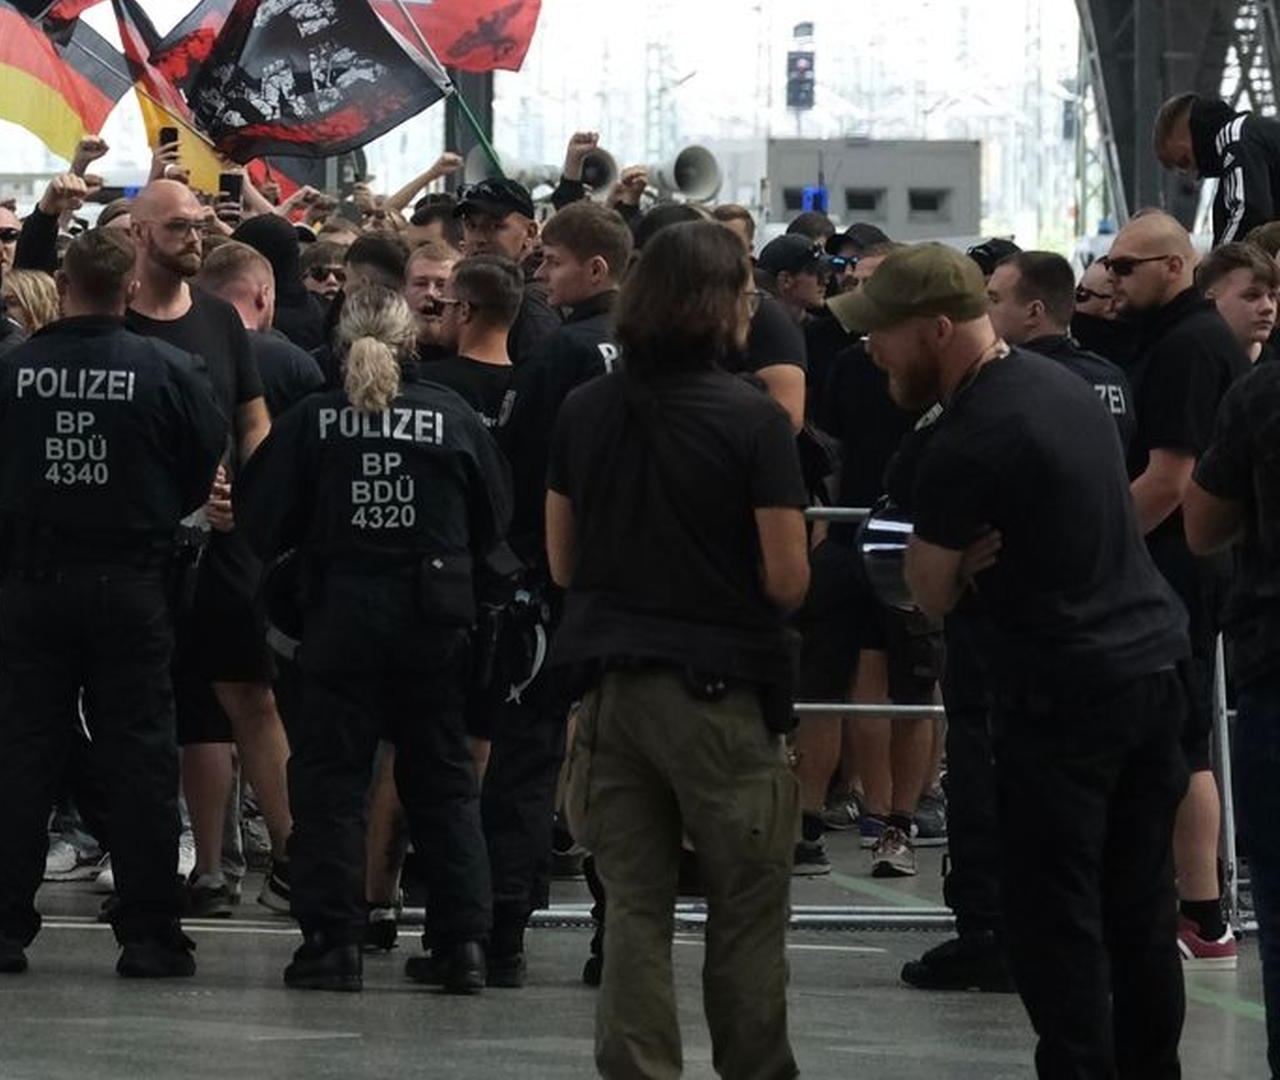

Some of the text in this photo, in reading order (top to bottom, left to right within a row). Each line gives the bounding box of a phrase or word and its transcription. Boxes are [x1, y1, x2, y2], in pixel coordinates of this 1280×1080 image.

[17, 367, 135, 401] POLIZEI
[56, 411, 95, 434] BP
[319, 406, 443, 444] POLIZEI
[46, 435, 107, 461] BDÜ
[45, 462, 109, 485] 4340
[362, 453, 402, 476] BP
[351, 475, 414, 503] BDÜ
[351, 505, 415, 529] 4320
